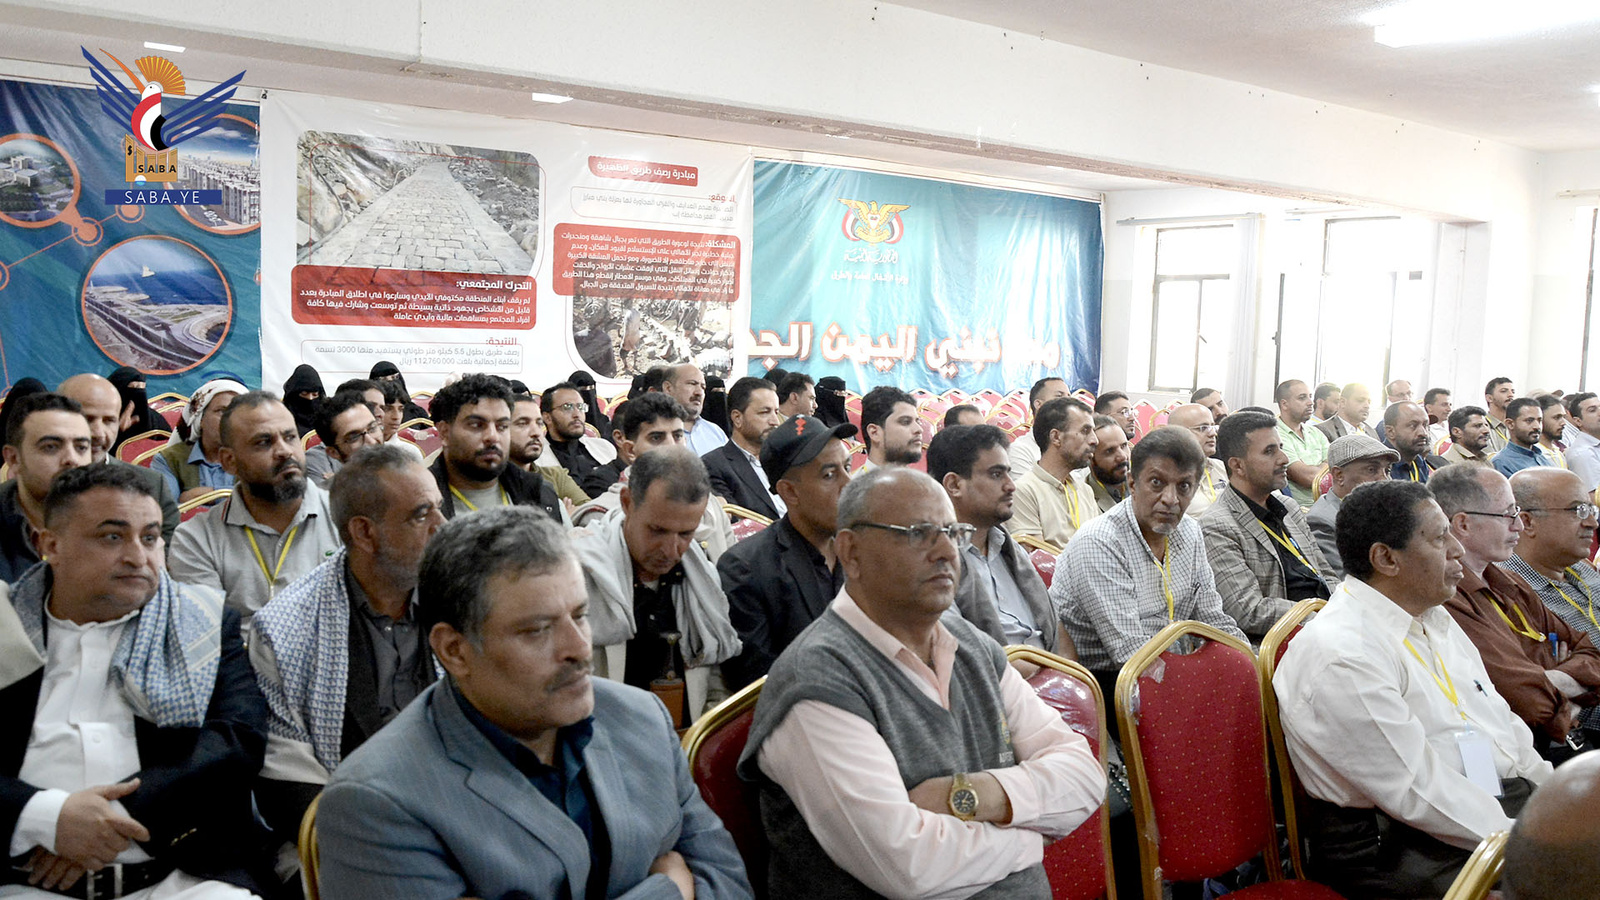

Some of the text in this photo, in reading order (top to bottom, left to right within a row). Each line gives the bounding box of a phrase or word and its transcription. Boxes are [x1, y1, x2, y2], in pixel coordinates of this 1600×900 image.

[630, 166, 652, 176] طريق
[654, 167, 671, 178] رصف
[672, 169, 696, 180] مبادرة
[561, 231, 589, 241] ومنحدرات
[590, 233, 611, 241] شاهقة
[612, 235, 627, 243] بجبال
[637, 236, 651, 244] التي
[652, 238, 671, 246] الطريق
[671, 239, 689, 248] لوعورة
[705, 239, 736, 249] المشكلة:
[570, 243, 588, 251] وعدم
[657, 247, 669, 255] على
[567, 252, 587, 260] الكبيرة
[588, 252, 610, 260] المشقة
[615, 263, 634, 272] عشرات
[562, 270, 582, 278] الطريق
[634, 274, 651, 282] موسم
[456, 279, 532, 292] التحرك المجتمعي:
[609, 281, 634, 289] المتدفقة
[635, 282, 656, 291] للسيول
[658, 284, 672, 292] نتيجة
[300, 289, 317, 297] بعدد
[318, 288, 344, 298] المبادرة
[728, 286, 734, 294] ما
[369, 291, 382, 300] في
[383, 291, 410, 301] وسارعوا
[434, 293, 464, 303] مكتوفي
[465, 295, 492, 303] المنطقة
[507, 296, 522, 304] يقف
[306, 299, 324, 307] كافة
[326, 299, 343, 309] فيها
[345, 300, 369, 310] وشارك
[523, 297, 531, 305] لم
[370, 302, 397, 311] توسعت
[398, 302, 407, 311] ثم
[408, 302, 432, 311] بسيطة
[434, 303, 451, 312] ذاتية
[452, 304, 473, 313] بجهود
[505, 306, 514, 314] من
[515, 306, 530, 315] قليل
[393, 312, 412, 320] عاملة
[436, 313, 452, 322] مالية
[454, 314, 488, 324] بمساهمات
[490, 315, 515, 325] المجتمع
[486, 336, 517, 348] النتيجة:
[337, 345, 356, 353] 3000
[403, 346, 424, 355] طولي
[426, 347, 436, 355] متر
[437, 347, 453, 355] كيلو
[454, 347, 465, 355] 5.5
[466, 347, 484, 356] بطول
[821, 322, 917, 372] اليمن
[485, 348, 503, 356] طريق
[504, 349, 520, 357] رصف
[399, 357, 412, 366] ريال
